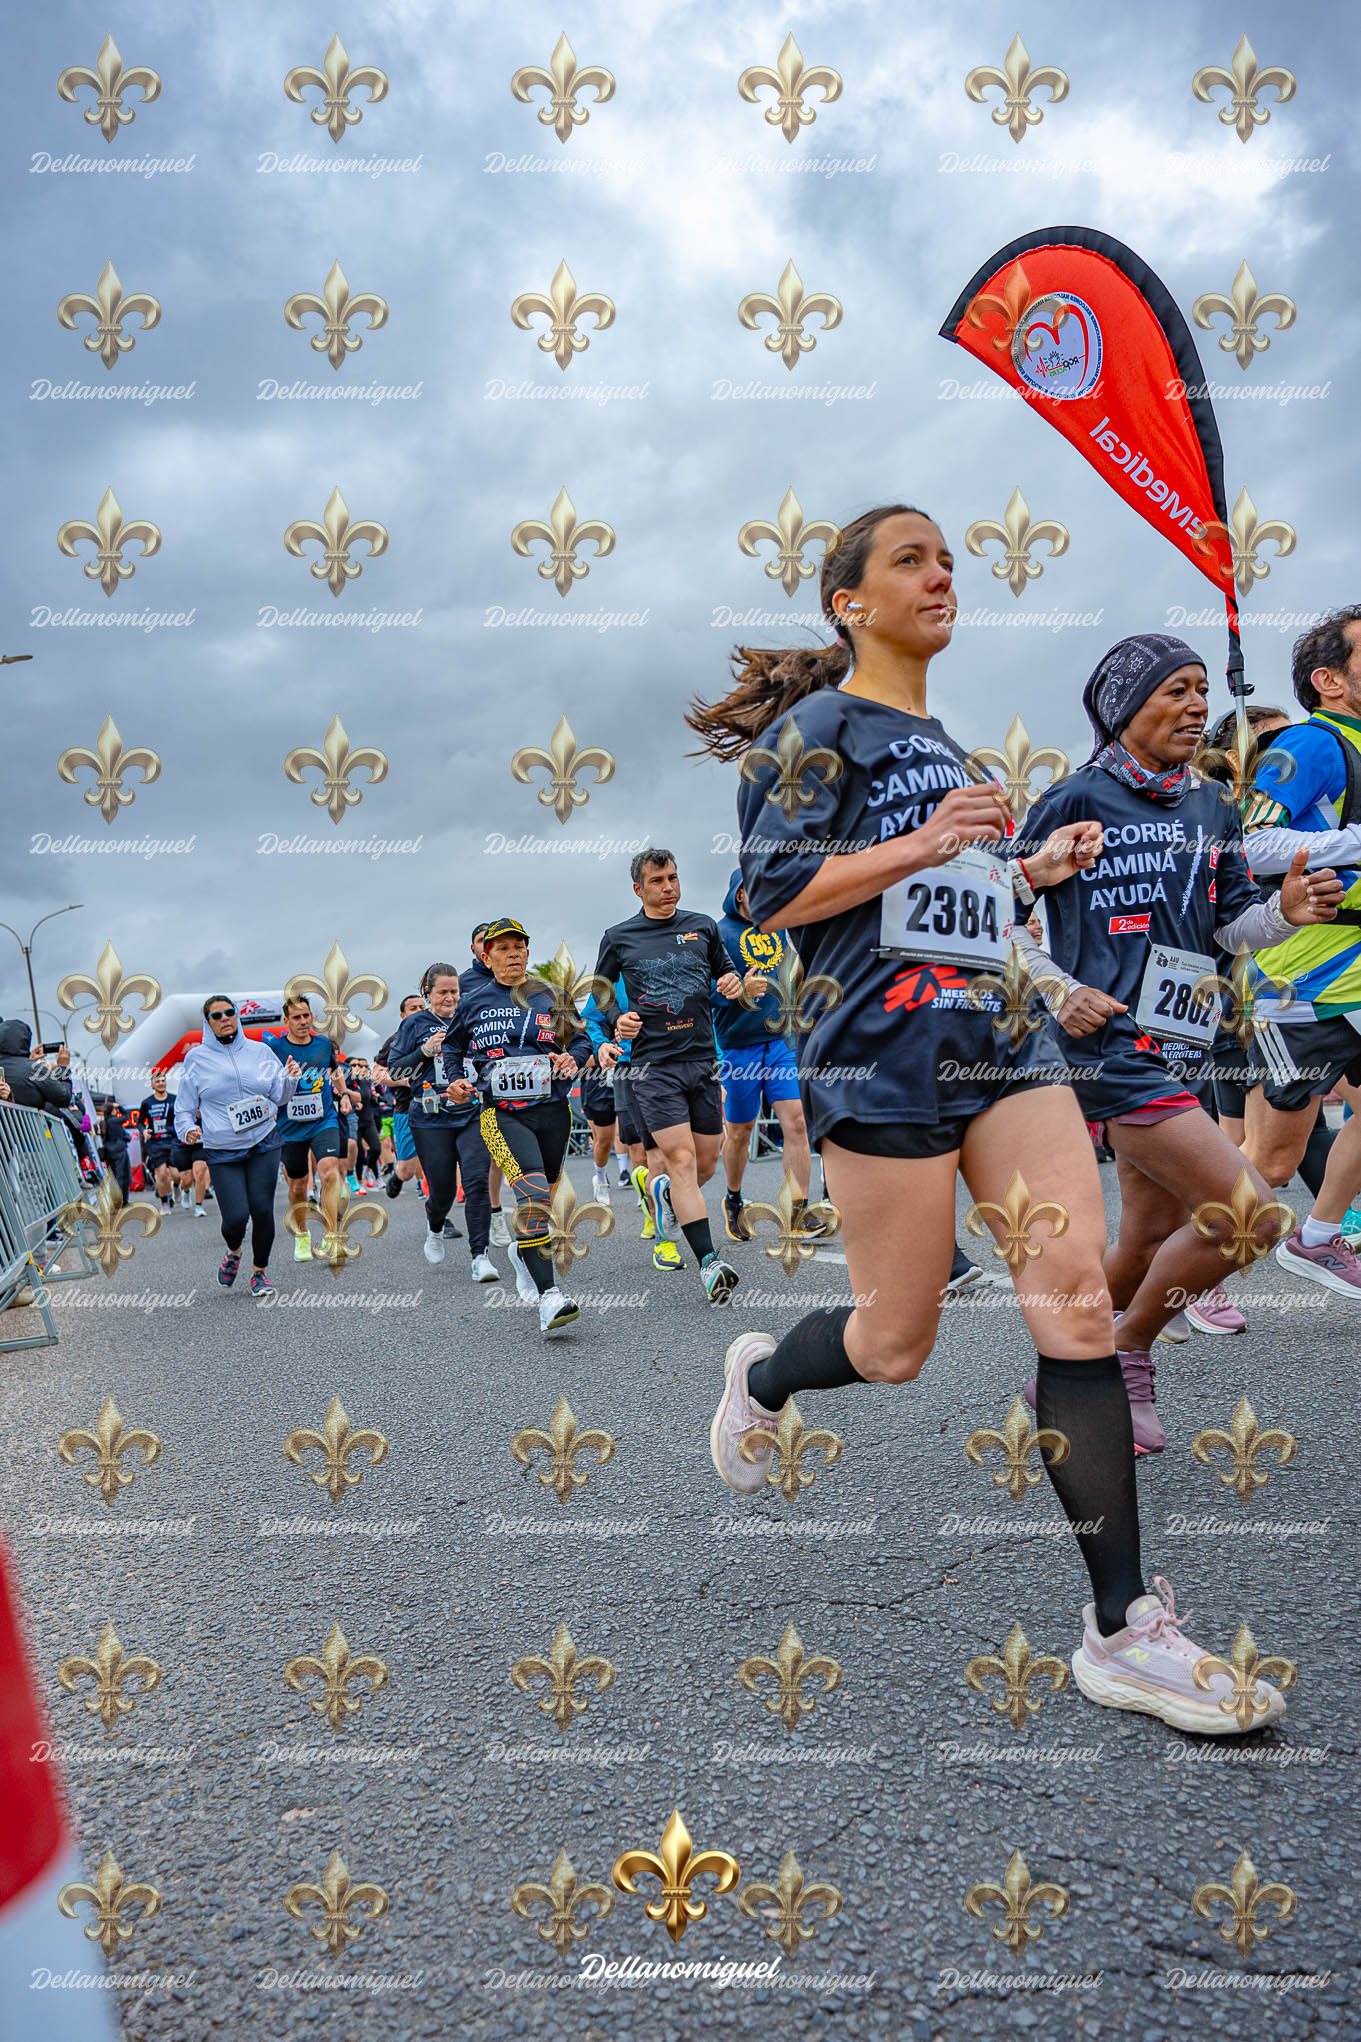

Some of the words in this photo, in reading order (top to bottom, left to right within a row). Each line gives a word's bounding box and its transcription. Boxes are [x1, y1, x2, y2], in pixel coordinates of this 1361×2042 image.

[880, 803, 941, 842] AYU
[1103, 819, 1185, 847] CORRÉ
[1080, 848, 1177, 882] CAMINÁ
[1089, 877, 1168, 911] AYUDÁ
[905, 882, 999, 943] 2384
[480, 1006, 521, 1019] CORRÉ
[931, 997, 954, 1009] SIN
[1154, 979, 1214, 1028] 2802
[473, 1019, 516, 1036] CAMINÁ
[477, 1032, 510, 1050] AYUDÁ
[498, 1071, 534, 1091] 3191
[235, 1105, 263, 1125] 2346
[292, 1103, 316, 1116] 2503
